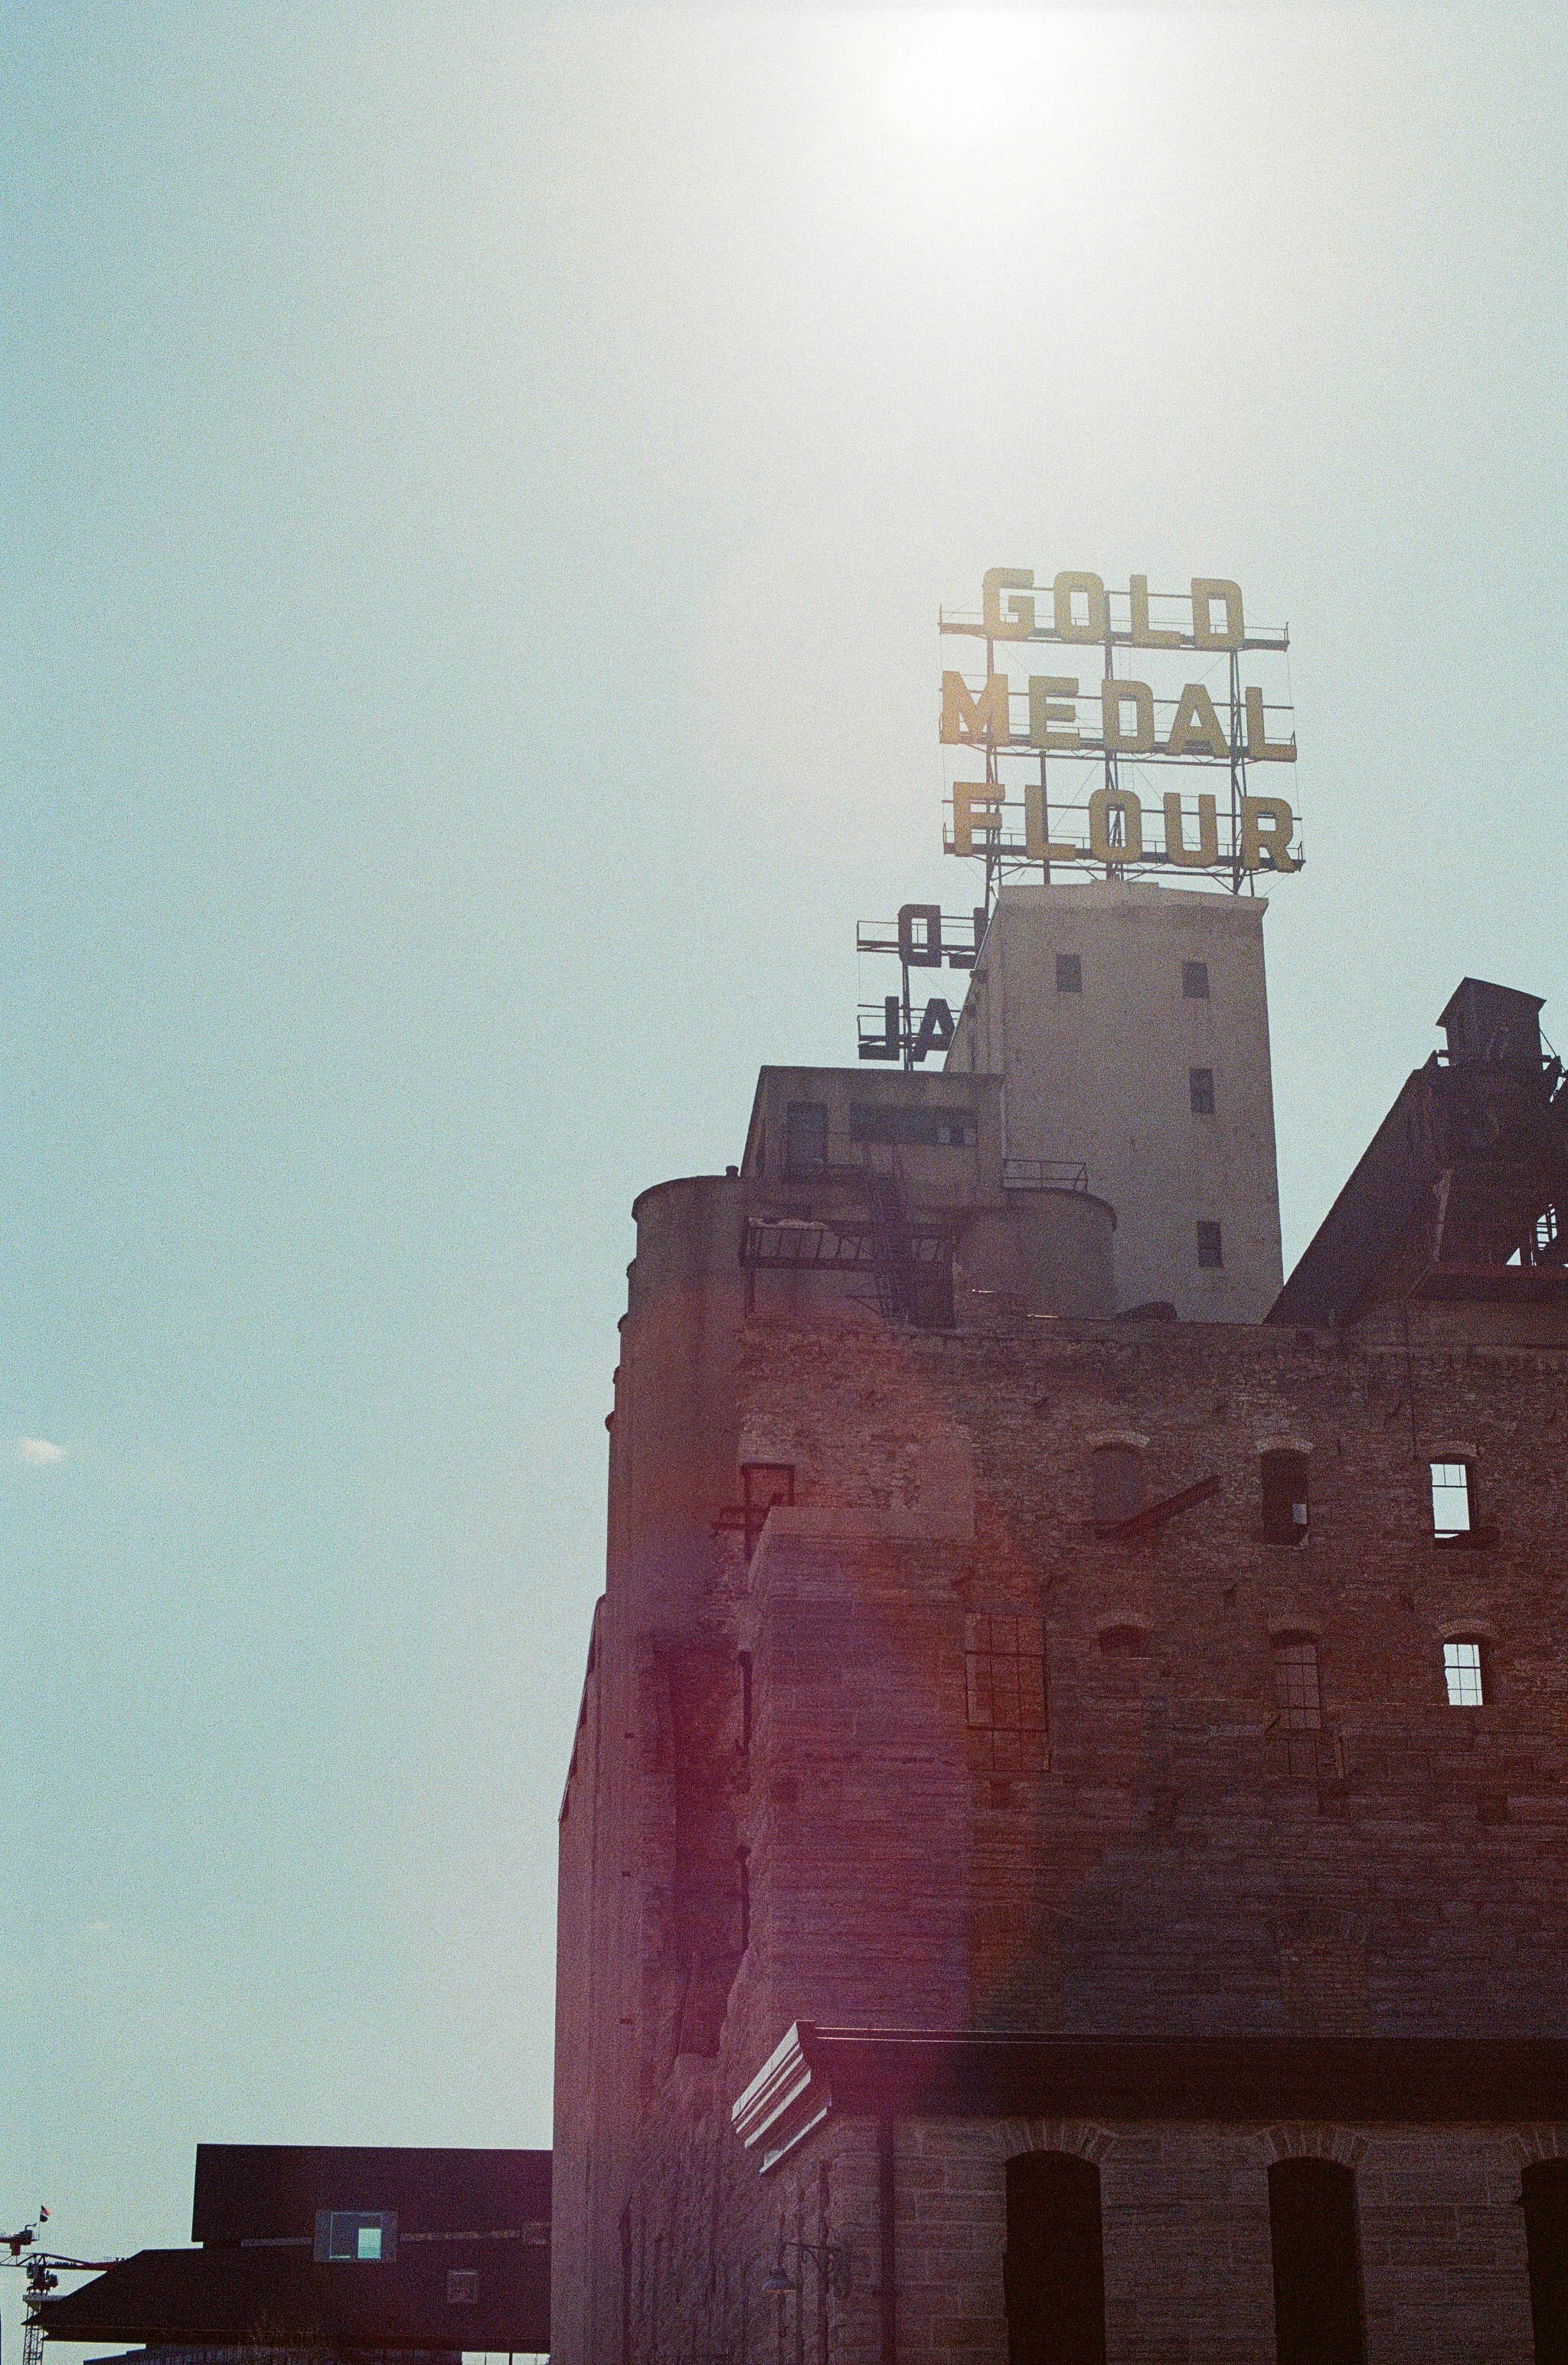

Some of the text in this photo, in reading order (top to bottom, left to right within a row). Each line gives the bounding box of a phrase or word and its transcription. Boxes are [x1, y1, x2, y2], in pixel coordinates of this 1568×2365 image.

[982, 568, 1245, 649] GOLD
[942, 671, 1298, 762] MEDAL
[953, 782, 1298, 872] FLOUR
